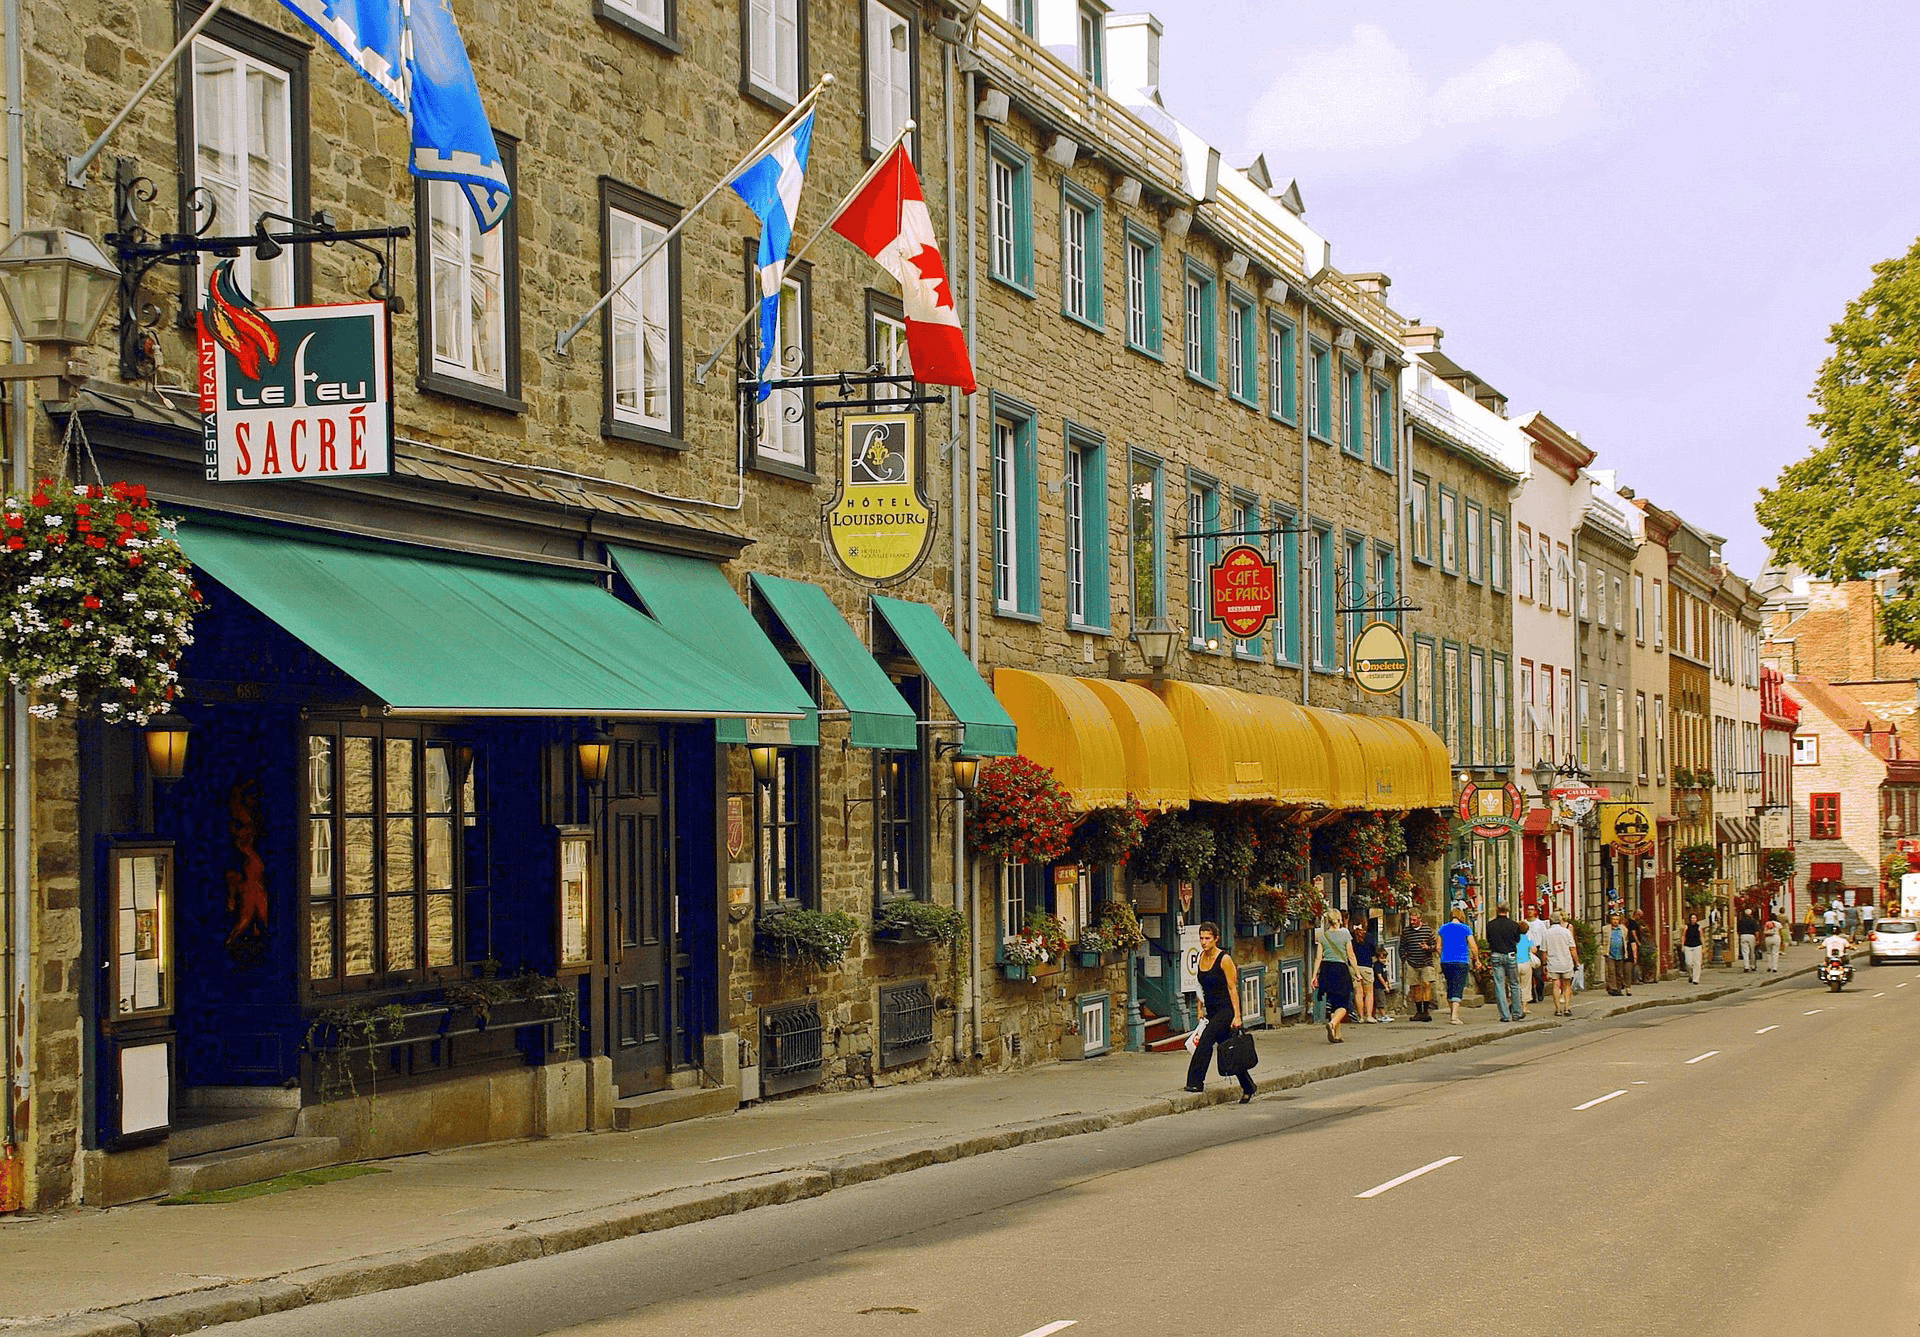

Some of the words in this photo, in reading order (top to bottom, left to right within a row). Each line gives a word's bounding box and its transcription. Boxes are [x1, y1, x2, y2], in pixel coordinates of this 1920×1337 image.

[235, 386, 285, 406] LE
[202, 338, 218, 482] RESTAURANT
[235, 404, 368, 476] SACRÉ
[847, 497, 911, 508] HÔTEL
[832, 511, 926, 527] LOUISBOURG
[1226, 569, 1261, 586] CAFÉ
[1216, 588, 1234, 602] DE
[1235, 586, 1272, 602] PARIS
